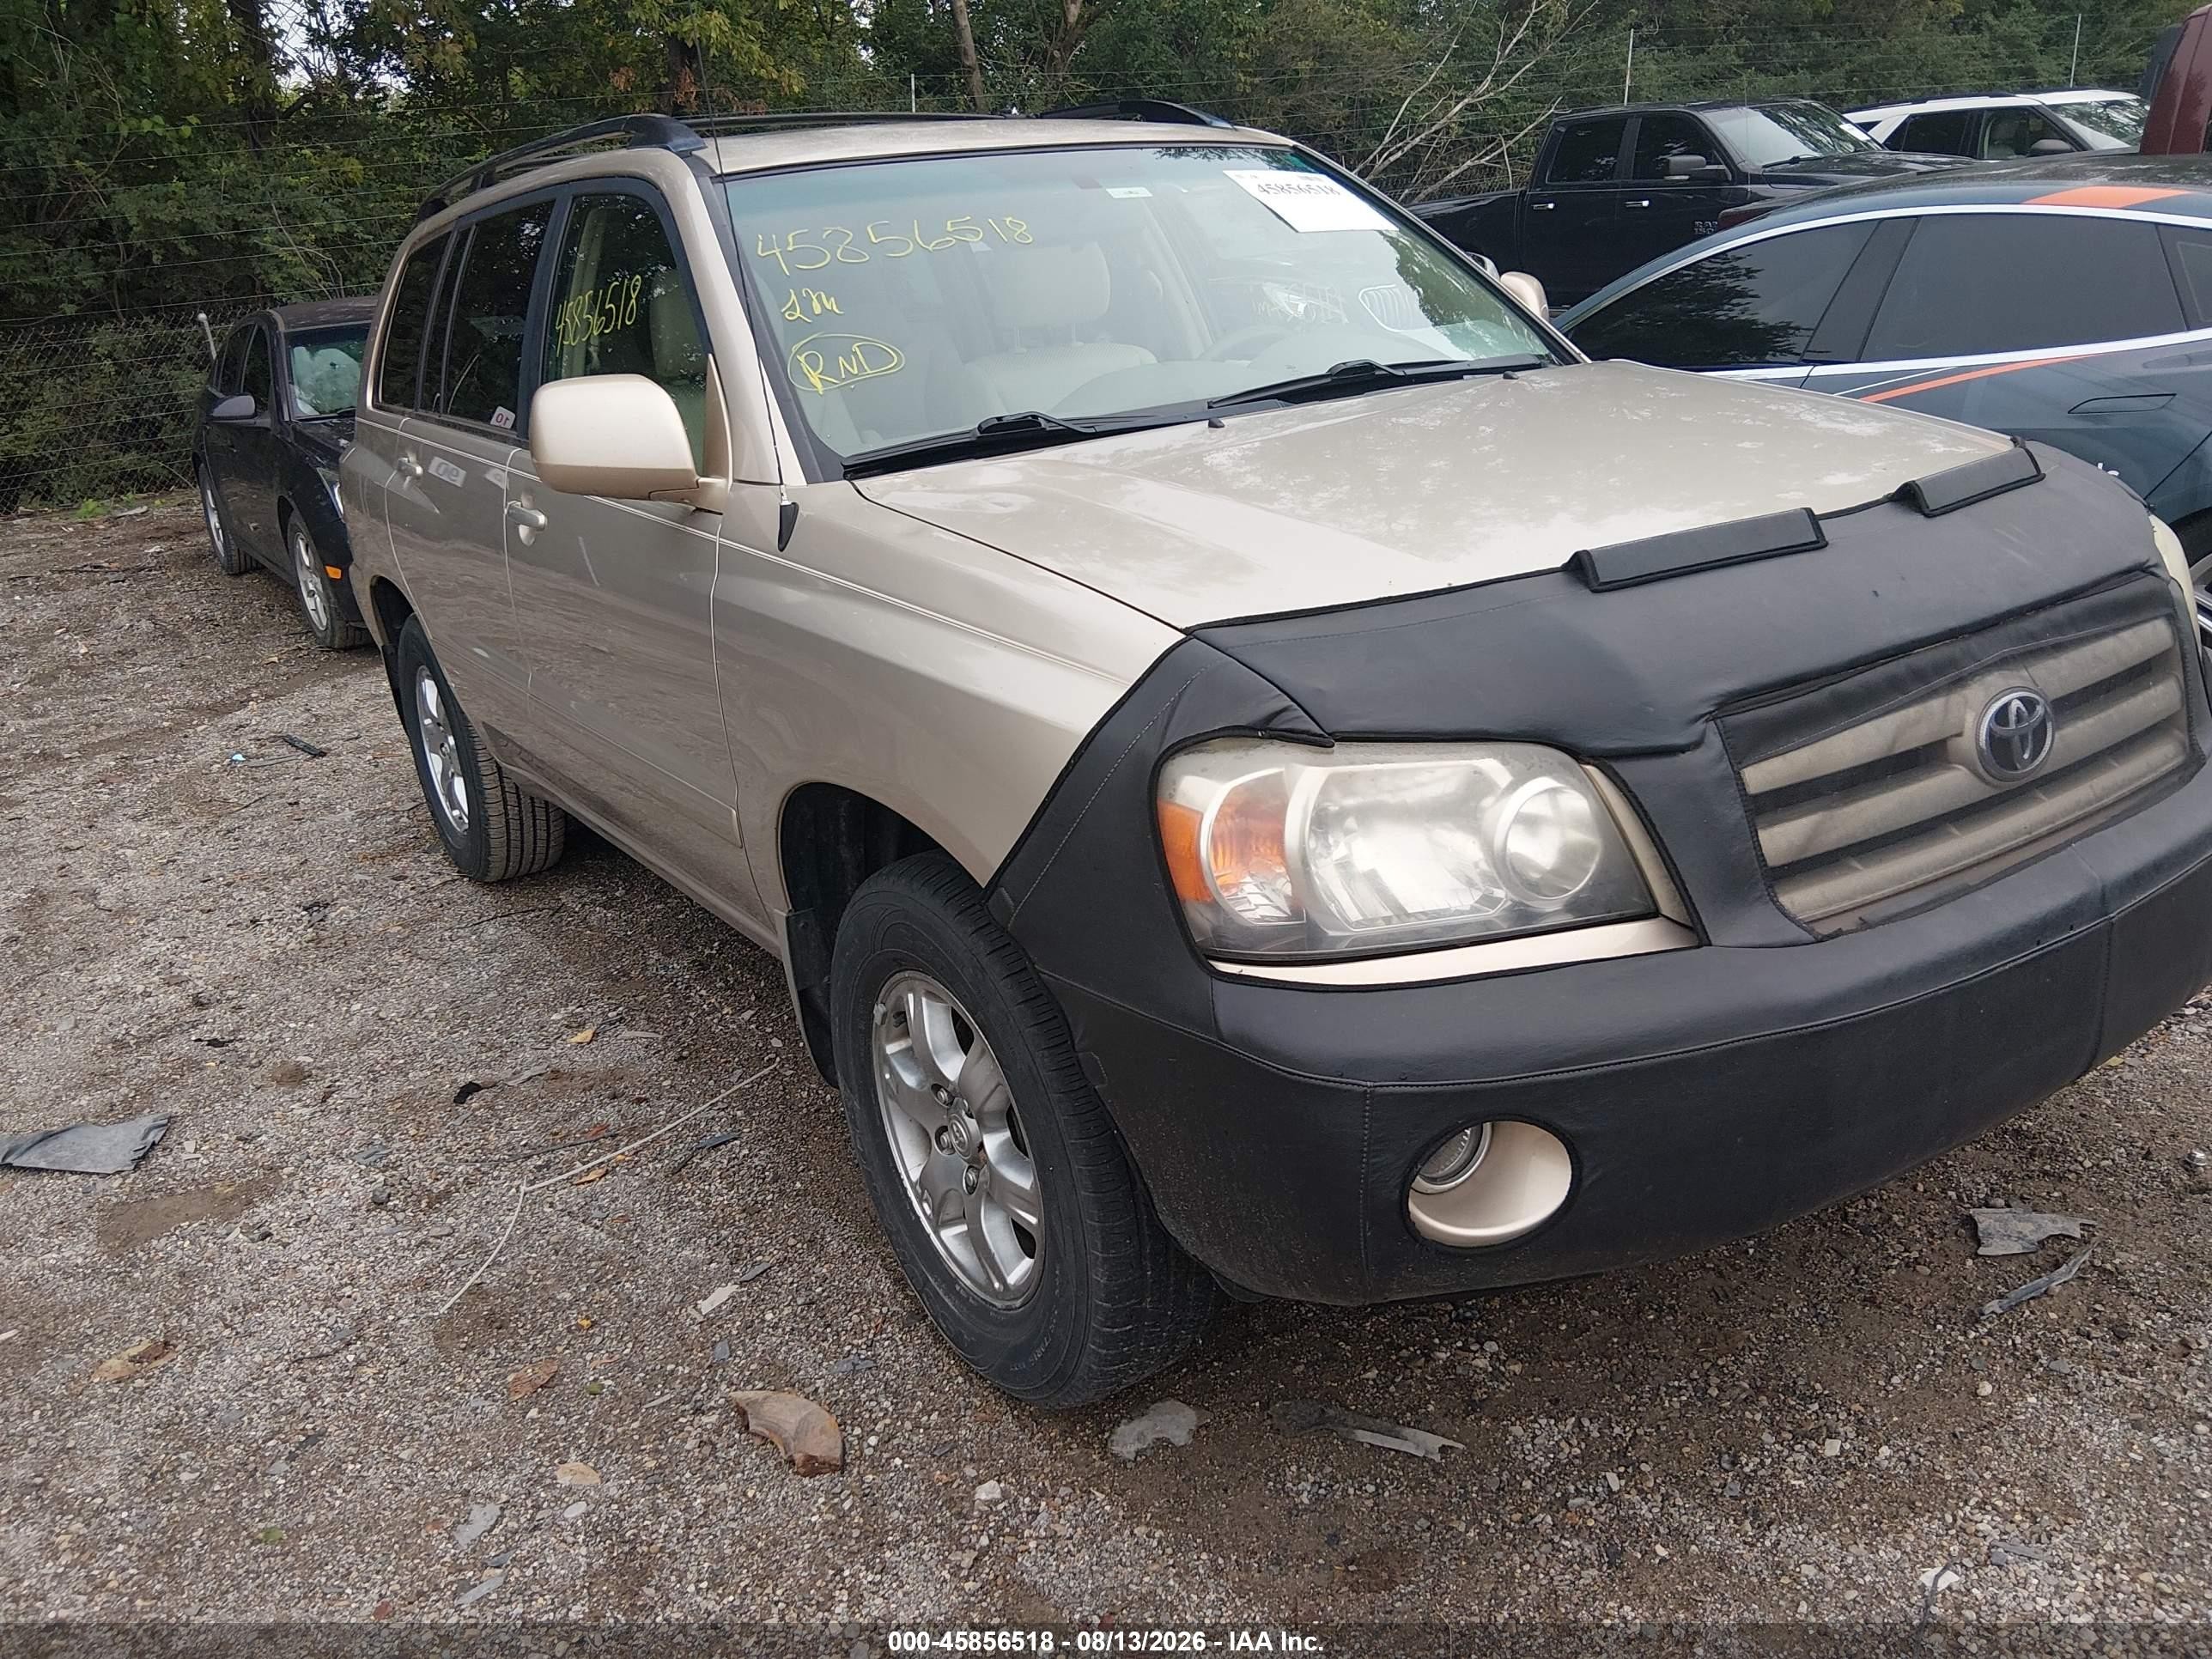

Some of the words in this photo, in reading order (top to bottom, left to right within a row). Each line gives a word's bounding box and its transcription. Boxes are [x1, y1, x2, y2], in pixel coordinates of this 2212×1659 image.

[757, 216, 1033, 277] 45856518
[555, 274, 642, 357] 45856518
[797, 342, 898, 395] RND
